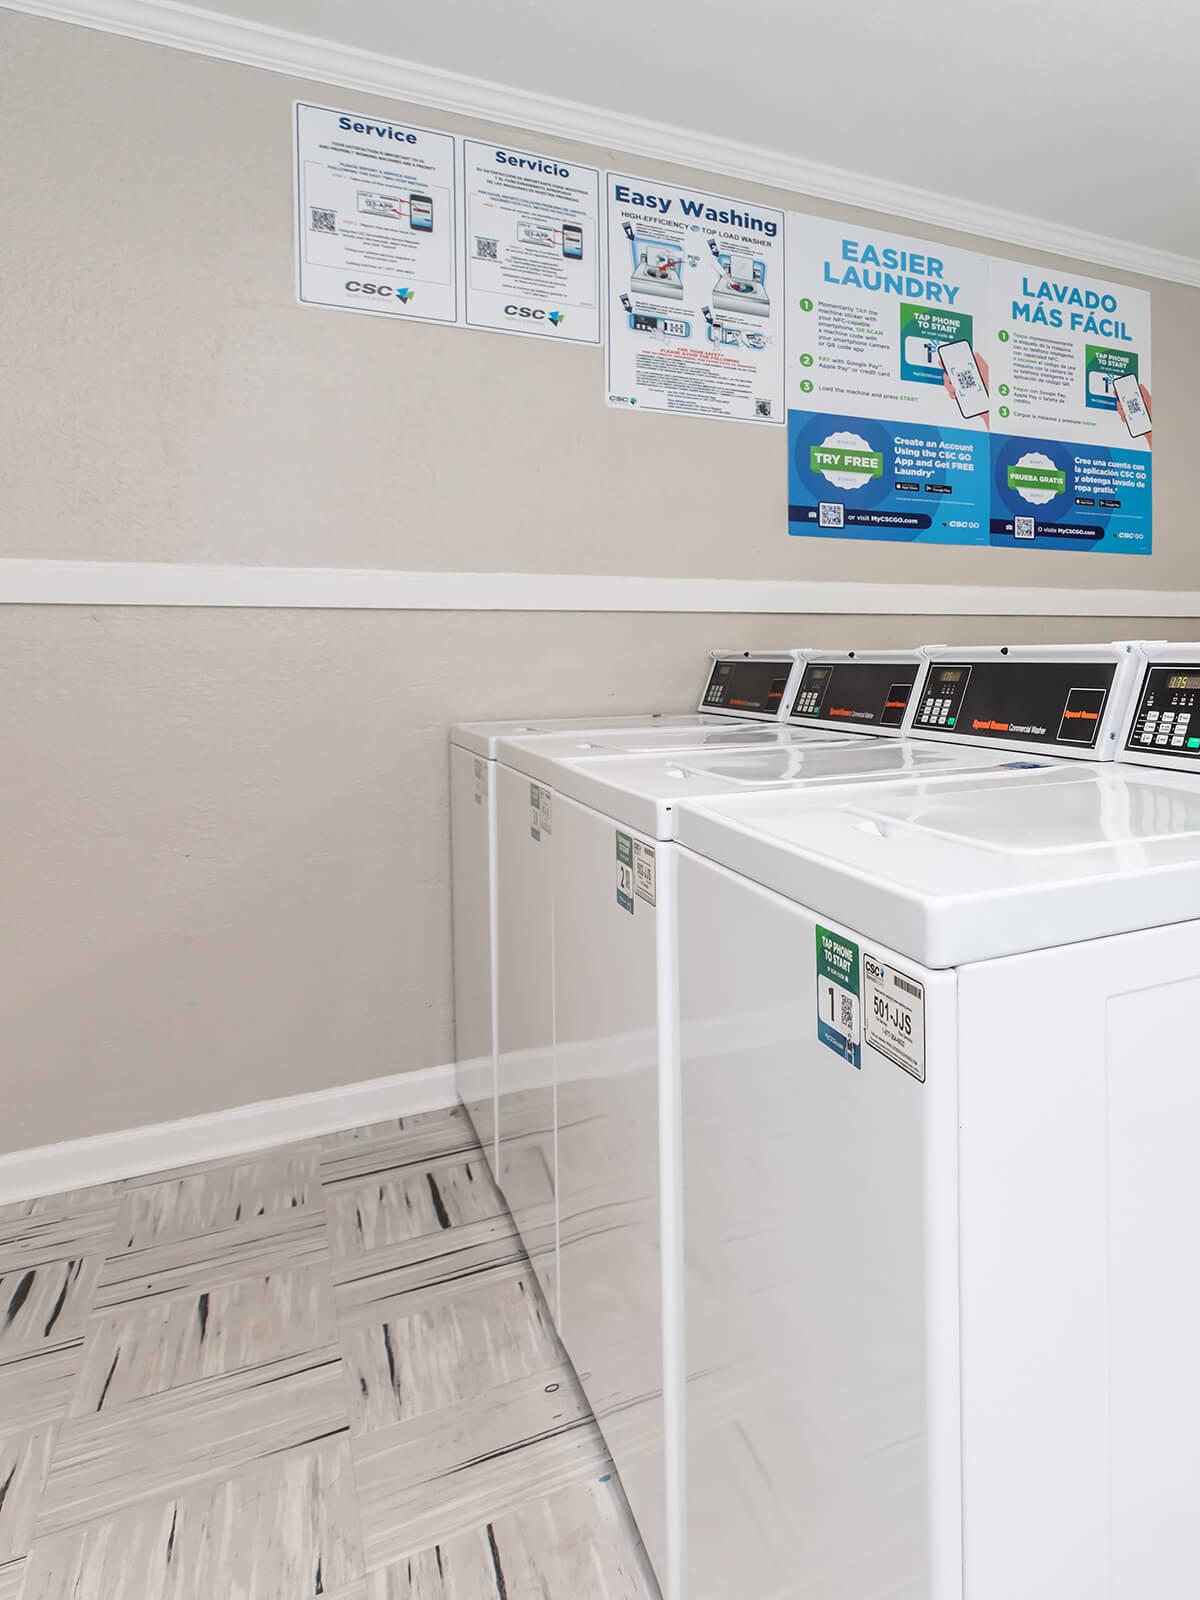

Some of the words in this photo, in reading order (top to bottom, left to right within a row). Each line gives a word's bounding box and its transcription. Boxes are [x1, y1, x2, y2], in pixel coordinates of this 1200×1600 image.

[338, 117, 417, 144] Service
[496, 151, 569, 177] Servicio
[615, 185, 672, 213] Easy
[680, 198, 777, 237] Washing
[621, 211, 688, 230] HIGH-EFFICIENCY
[702, 227, 717, 236] TOP
[719, 231, 740, 241] LOAD
[741, 235, 772, 247] WASHER
[842, 239, 944, 279] EASIER
[345, 281, 392, 296] CSC
[824, 261, 960, 305] LAUNDRY
[1023, 276, 1117, 313] LAVADO
[504, 305, 545, 319] CSC
[818, 301, 854, 312] Momentarily
[819, 308, 842, 316] machine
[914, 313, 930, 321] TAP
[932, 316, 960, 327] PHONE
[917, 320, 929, 328] TO
[931, 322, 957, 333] START
[1012, 301, 1063, 328] MÁS
[1070, 311, 1133, 341] FÁCIL
[824, 329, 848, 337] machine
[833, 337, 867, 346] smartphone
[869, 342, 890, 350] camera
[804, 356, 810, 365] 2
[846, 360, 866, 368] Google
[1109, 354, 1129, 363] PHONE
[804, 382, 810, 390] 3
[1001, 386, 1006, 394] 2
[1002, 408, 1007, 416] 3
[894, 437, 924, 447] Create
[926, 440, 937, 448] an
[939, 441, 973, 452] Account
[894, 446, 920, 458] Using
[922, 449, 936, 458] the
[938, 451, 955, 460] CSC
[814, 452, 840, 465] TRY
[844, 456, 879, 469] FREE
[894, 457, 913, 467] App
[916, 459, 932, 467] and
[934, 460, 950, 469] Get
[952, 461, 974, 471] FREE
[1075, 457, 1092, 465] Cree
[1108, 461, 1131, 469] cuenta
[1010, 473, 1038, 482] PRUEBA
[1039, 476, 1063, 485] GRATIS
[1083, 467, 1118, 477] aplicación
[1081, 475, 1111, 486] obtenga
[1112, 479, 1135, 487] lavado
[871, 515, 918, 524] MyCSCGO.com
[949, 520, 967, 528] CSC
[969, 521, 979, 529] GO
[621, 866, 624, 888] 2
[822, 935, 832, 948] TAP
[833, 940, 853, 958] PHONE
[824, 950, 832, 962] TO
[832, 953, 851, 973] START
[865, 961, 880, 977] CSC
[828, 988, 834, 1022] 1
[874, 995, 912, 1036] 501-JJS
